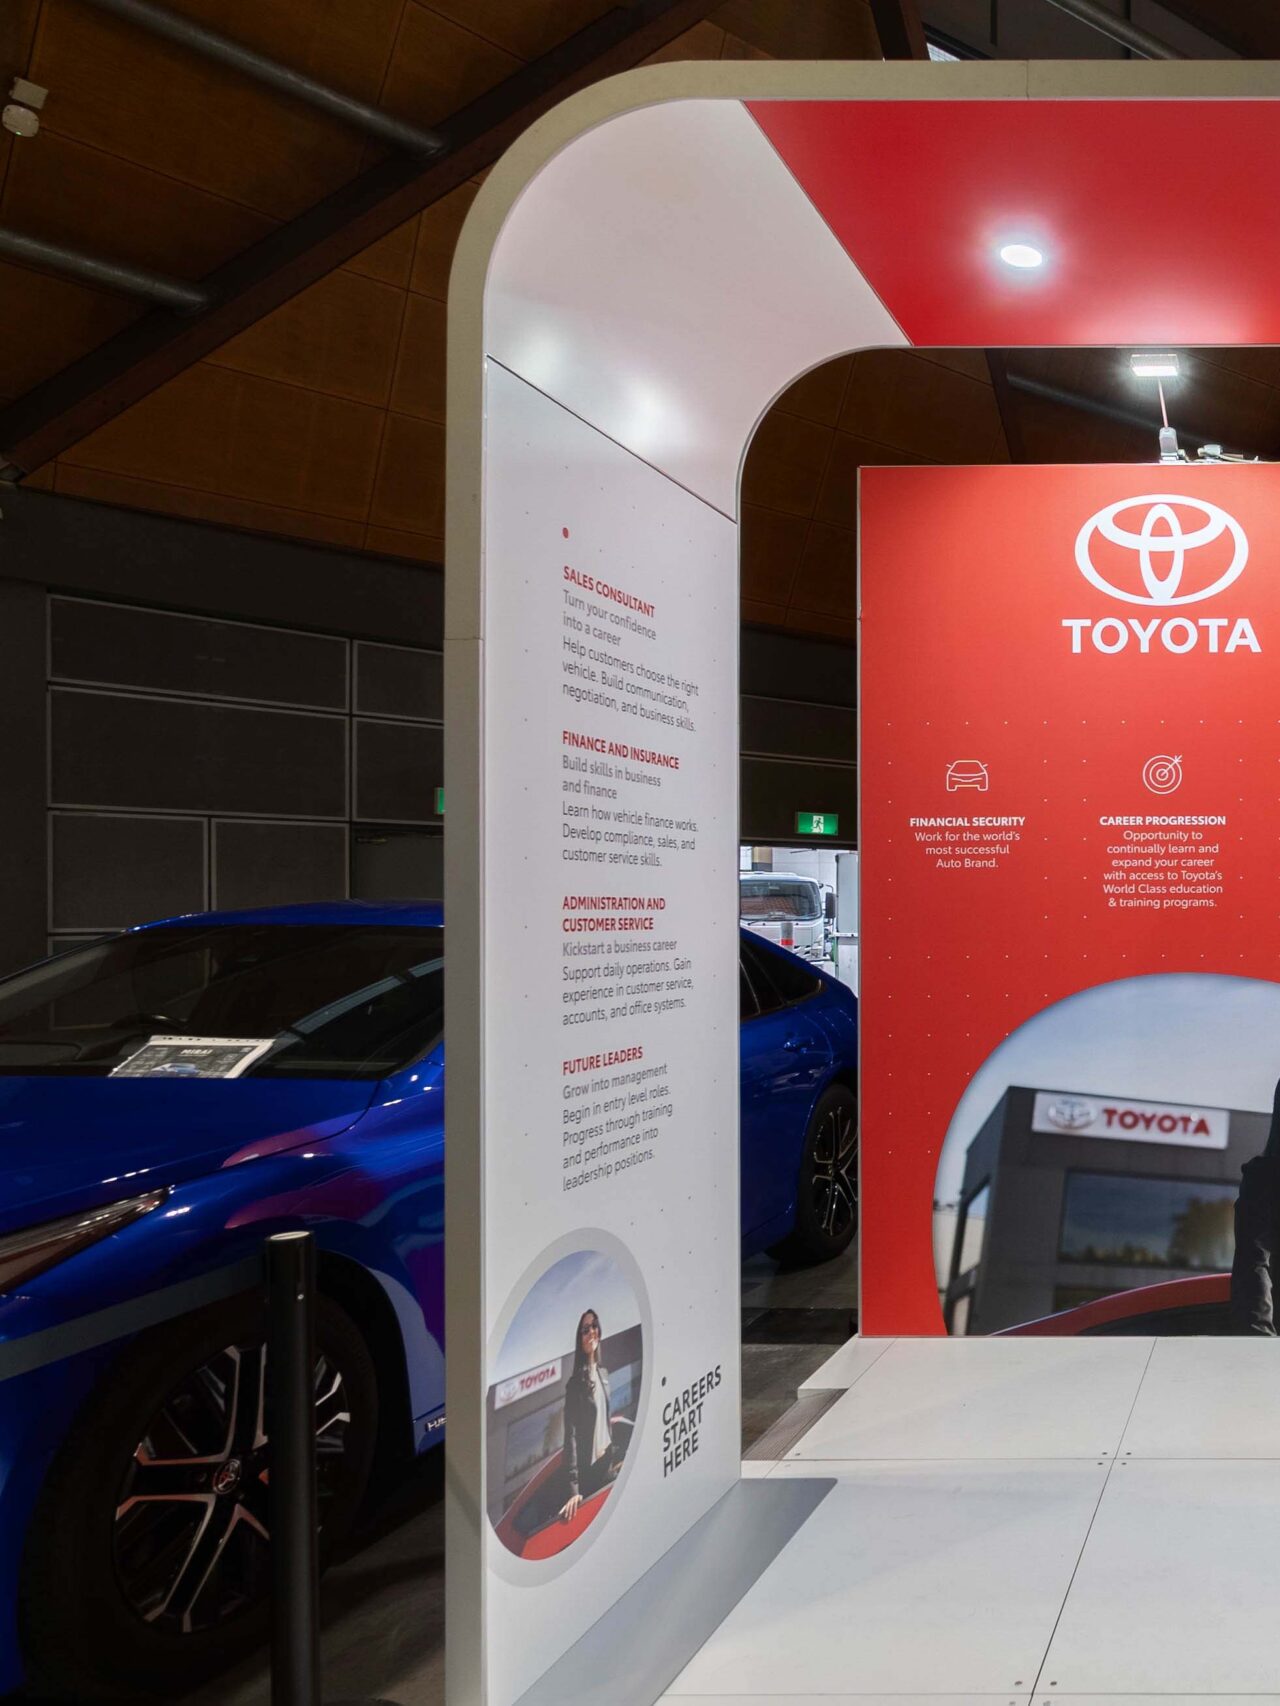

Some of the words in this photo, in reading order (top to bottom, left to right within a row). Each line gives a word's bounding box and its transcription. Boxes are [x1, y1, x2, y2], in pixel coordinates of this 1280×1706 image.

[564, 566, 593, 591] SALES
[596, 581, 655, 617] CONSULTANT
[563, 589, 584, 610] Turn
[587, 603, 608, 619] your
[610, 612, 656, 640] confidence
[563, 611, 582, 631] into
[585, 624, 590, 635] a
[593, 627, 621, 646] career
[1062, 617, 1262, 654] TOYOTA
[563, 636, 586, 659] Help
[589, 648, 634, 673] customers
[636, 664, 666, 684] choose
[667, 673, 679, 690] the
[682, 680, 699, 696] right
[563, 660, 599, 682] vehicle.
[602, 671, 624, 691] Build
[626, 681, 689, 713] communication,
[563, 683, 619, 712] negotiation,
[622, 701, 637, 716] and
[640, 704, 674, 726] business
[676, 716, 696, 732] skills.
[563, 730, 606, 753] FINANCE
[608, 741, 628, 758] AND
[630, 746, 679, 769] INSURANCE
[563, 755, 587, 772] Build
[590, 761, 613, 778] skills
[615, 765, 622, 779] in
[625, 767, 661, 787] business
[562, 780, 581, 793] and
[583, 780, 617, 799] finance
[563, 801, 589, 818] Learn
[592, 805, 611, 821] how
[613, 809, 642, 826] vehicle
[645, 812, 674, 829] finance
[675, 818, 699, 832] works.
[910, 817, 970, 827] FINANCIAL
[972, 817, 1025, 826] SECURITY
[1100, 816, 1143, 825] CAREER
[1146, 816, 1226, 825] PROGRESSION
[563, 823, 601, 841] Develop
[604, 830, 655, 848] compliance,
[658, 835, 679, 851] sales,
[681, 838, 695, 850] and
[915, 832, 942, 841] Work
[945, 832, 959, 841] for
[963, 832, 980, 841] the
[926, 846, 952, 855] most
[955, 844, 1009, 854] successful
[1107, 844, 1166, 855] continually
[1169, 844, 1195, 853] learn
[1199, 844, 1219, 853] and
[1123, 831, 1188, 842] Opportunity
[1192, 831, 1203, 840] to
[563, 848, 606, 863] customer
[609, 851, 638, 865] service
[640, 852, 662, 867] skills.
[936, 859, 961, 868] Auto
[965, 858, 999, 867] Brand.
[1112, 858, 1152, 868] expand
[1154, 859, 1178, 868] your
[1181, 859, 1214, 867] career
[1103, 884, 1135, 893] World
[1138, 884, 1166, 893] Class
[1170, 884, 1223, 893] education
[1104, 870, 1126, 880] with
[1129, 872, 1164, 880] access
[1168, 871, 1178, 880] to
[563, 896, 644, 910] ADMINISTRATION
[647, 898, 665, 910] AND
[1108, 898, 1116, 907] &
[1120, 898, 1160, 908] training
[1163, 900, 1217, 909] programs.
[563, 918, 616, 932] CUSTOMER
[618, 918, 654, 930] SERVICE
[563, 941, 604, 957] Kickstart
[607, 944, 612, 954] a
[614, 940, 651, 953] business
[653, 940, 677, 951] career
[563, 966, 601, 983] Support
[603, 962, 624, 979] daily
[626, 960, 671, 977] operations.
[674, 957, 692, 971] Gain
[563, 986, 613, 1005] experience
[616, 983, 624, 997] in
[626, 982, 664, 995] customer
[666, 977, 694, 990] service,
[563, 1007, 608, 1025] accounts,
[610, 1003, 627, 1018] and
[629, 1000, 652, 1016] office
[654, 997, 687, 1015] systems.
[563, 1054, 600, 1075] FUTURE
[603, 1046, 643, 1066] LEADERS
[563, 1084, 589, 1099] Grow
[591, 1077, 610, 1092] into
[611, 1063, 668, 1088] management
[563, 1105, 590, 1125] Begin
[593, 1102, 601, 1115] in
[603, 1096, 626, 1112] entry
[628, 1088, 647, 1106] level
[649, 1084, 671, 1099] roles.
[563, 1124, 603, 1147] Progress
[606, 1112, 640, 1133] through
[642, 1103, 673, 1121] training
[1103, 1108, 1210, 1136] TOYOTA
[563, 1150, 581, 1169] and
[584, 1133, 640, 1165] performance
[642, 1127, 658, 1140] into
[563, 1163, 612, 1191] leadership
[615, 1148, 655, 1176] positions.
[519, 1366, 556, 1392] TOYOTA
[663, 1365, 722, 1425] CAREERS
[663, 1401, 704, 1452] START
[664, 1430, 698, 1478] HERE
